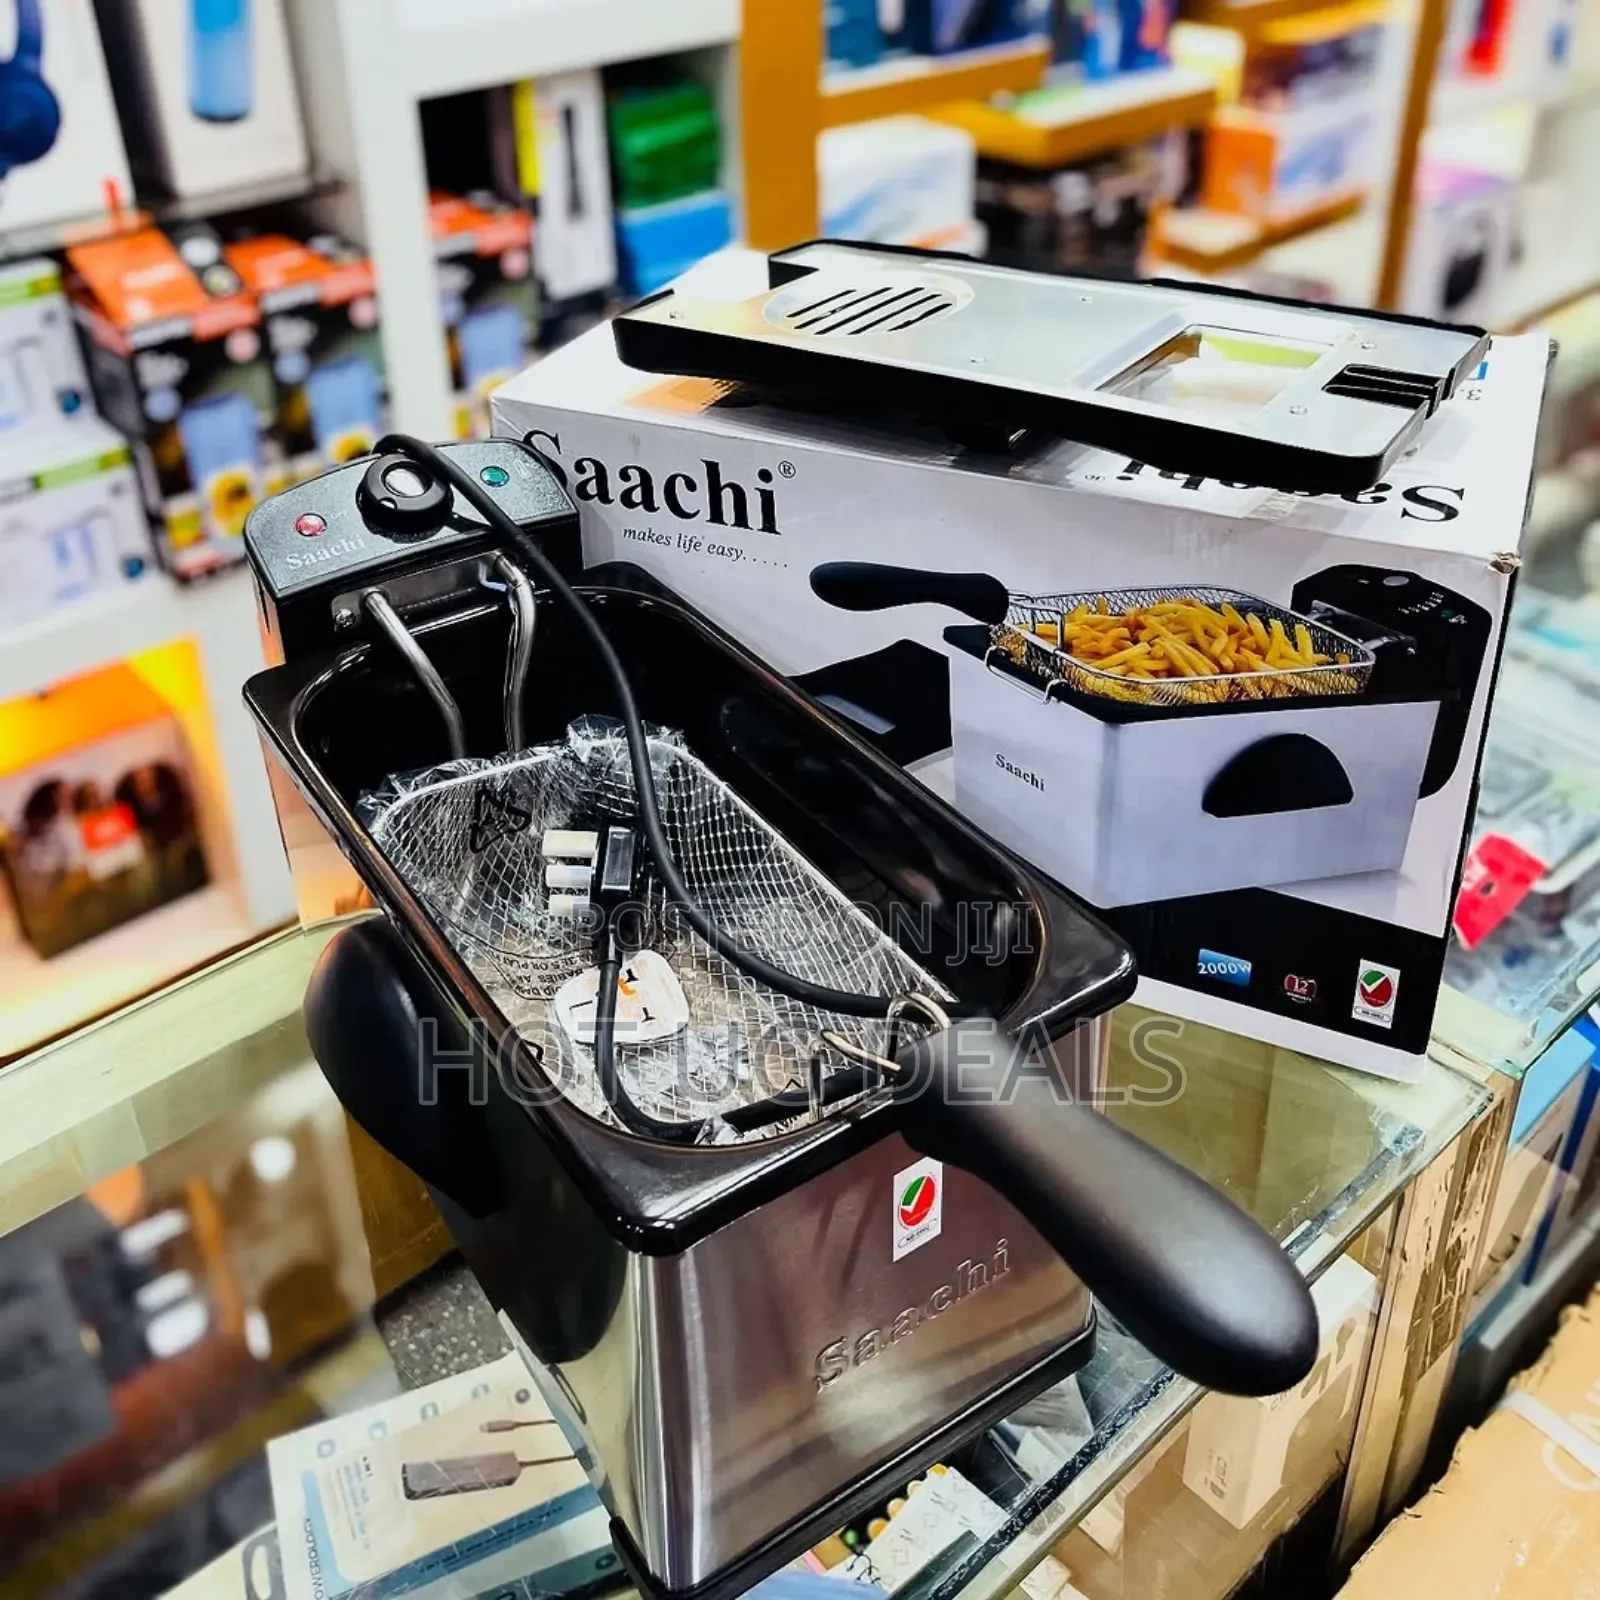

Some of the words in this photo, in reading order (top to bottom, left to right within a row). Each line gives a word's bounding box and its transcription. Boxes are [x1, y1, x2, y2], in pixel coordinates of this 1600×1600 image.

[286, 534, 367, 570] Saachi
[623, 526, 672, 547] makes
[677, 532, 703, 553] life
[996, 753, 1045, 792] Saachi
[1197, 962, 1252, 977] 2000W
[813, 1237, 1011, 1396] Saachi
